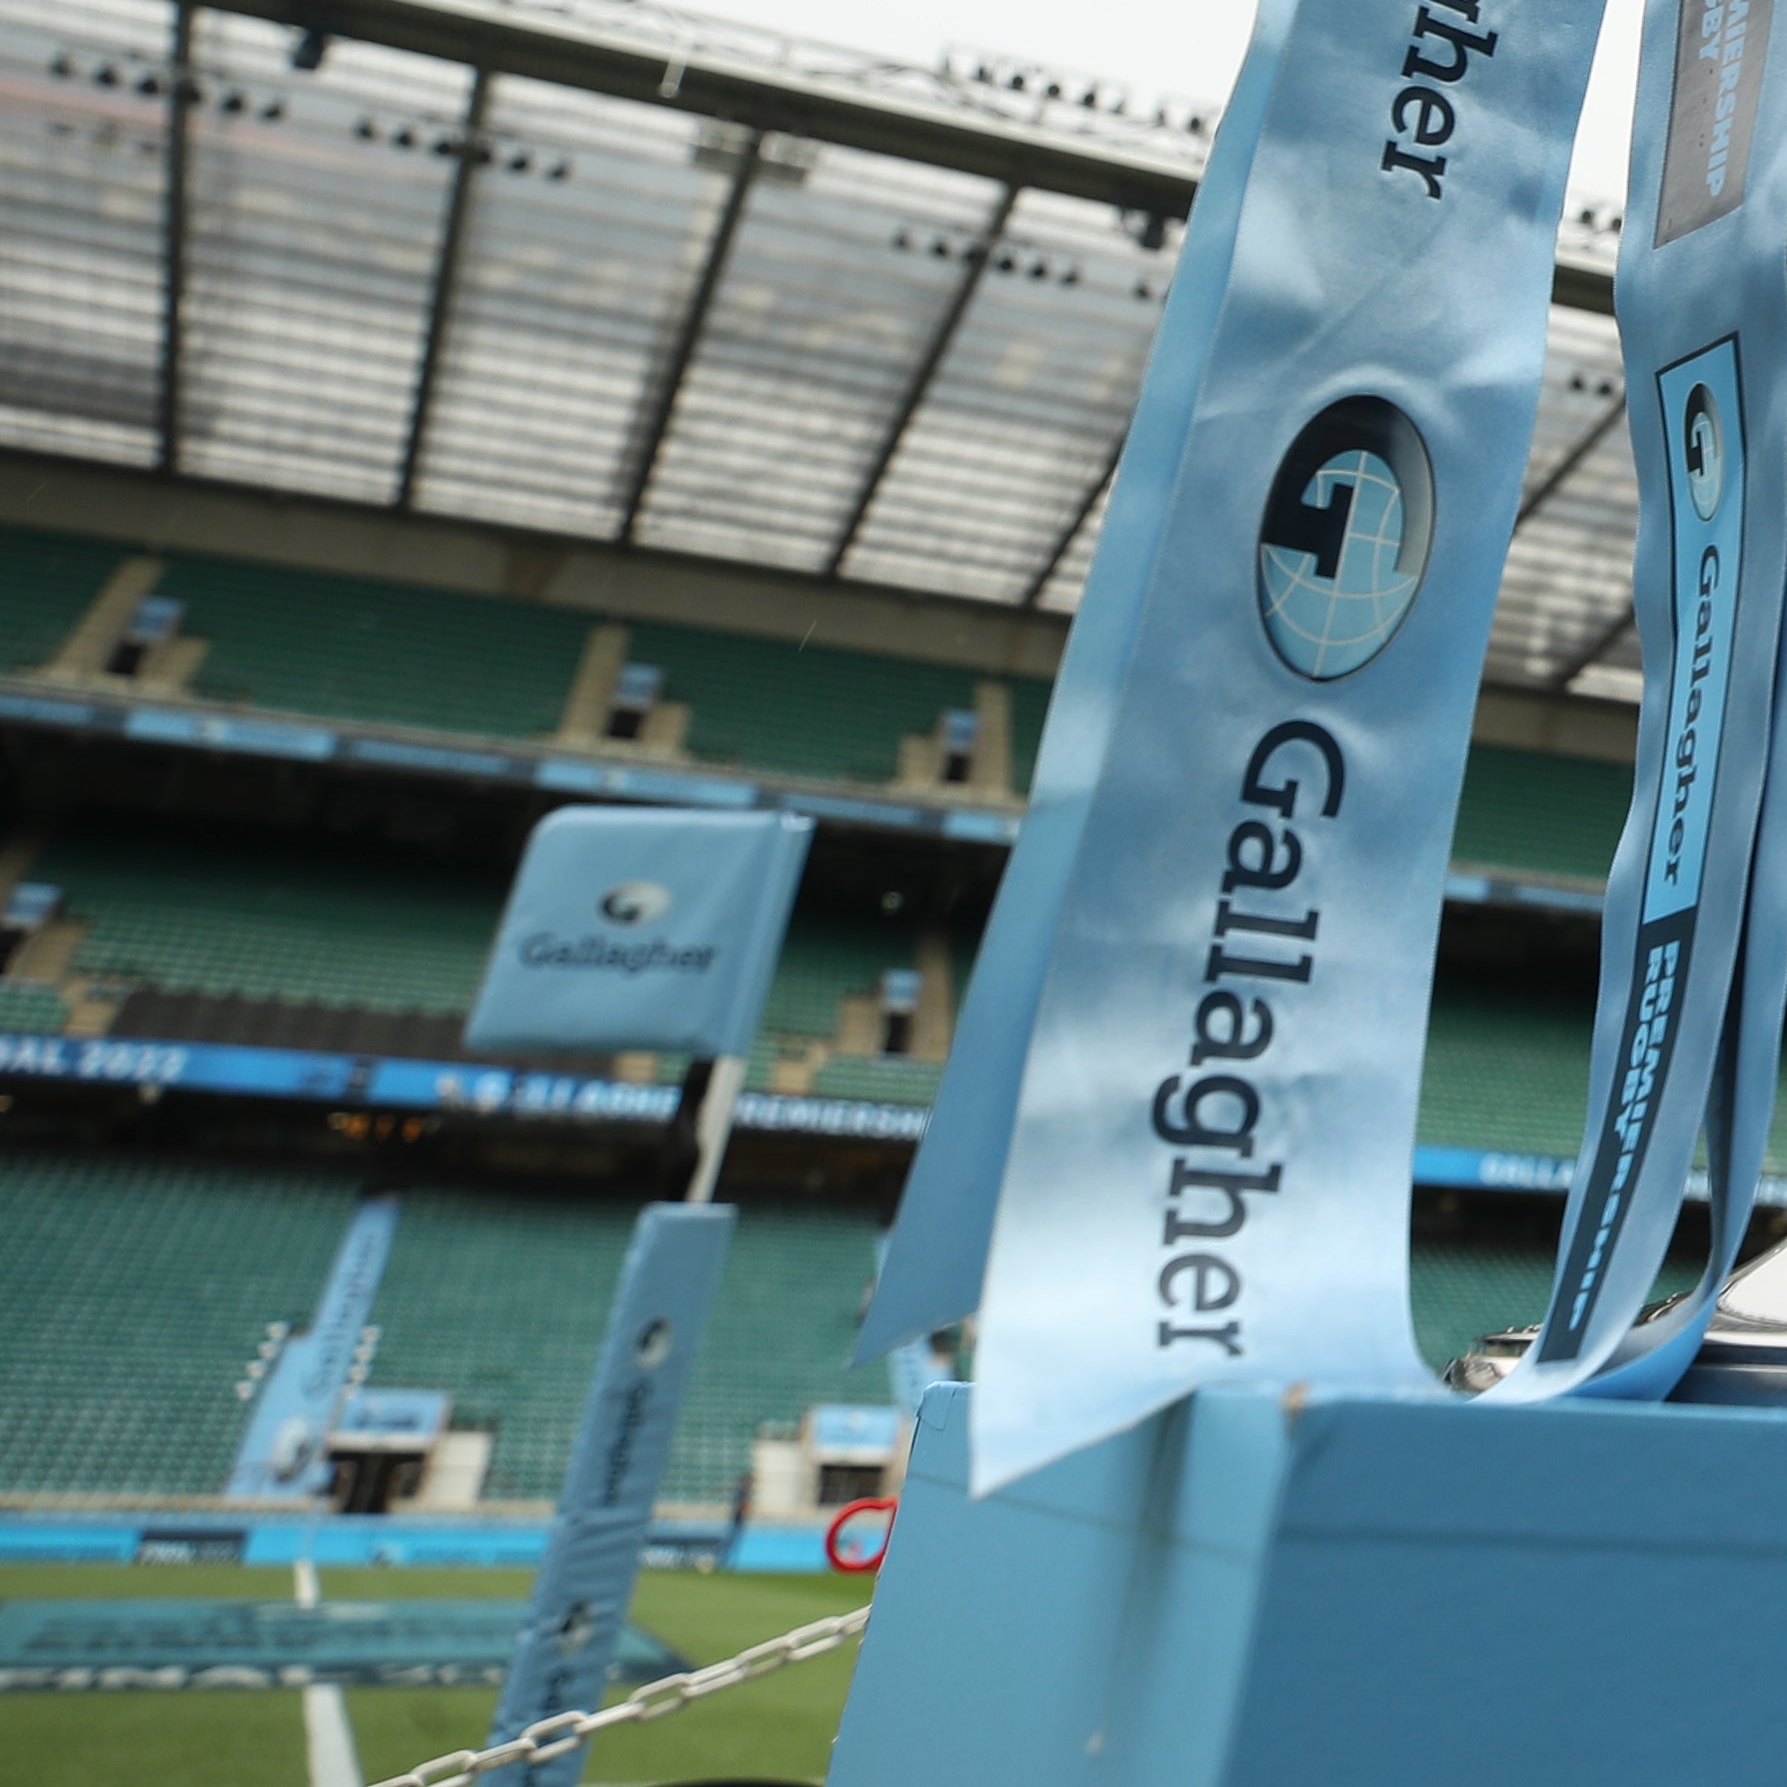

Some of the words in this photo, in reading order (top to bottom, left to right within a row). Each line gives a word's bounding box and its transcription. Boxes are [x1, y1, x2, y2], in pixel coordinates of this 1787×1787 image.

[1665, 544, 1718, 887] Gallagher
[519, 931, 717, 977] Gallagher
[1150, 719, 1346, 1358] Gallagher
[1615, 946, 1663, 1141] RUGBY
[1569, 940, 1681, 1331] PREMIERSHIP
